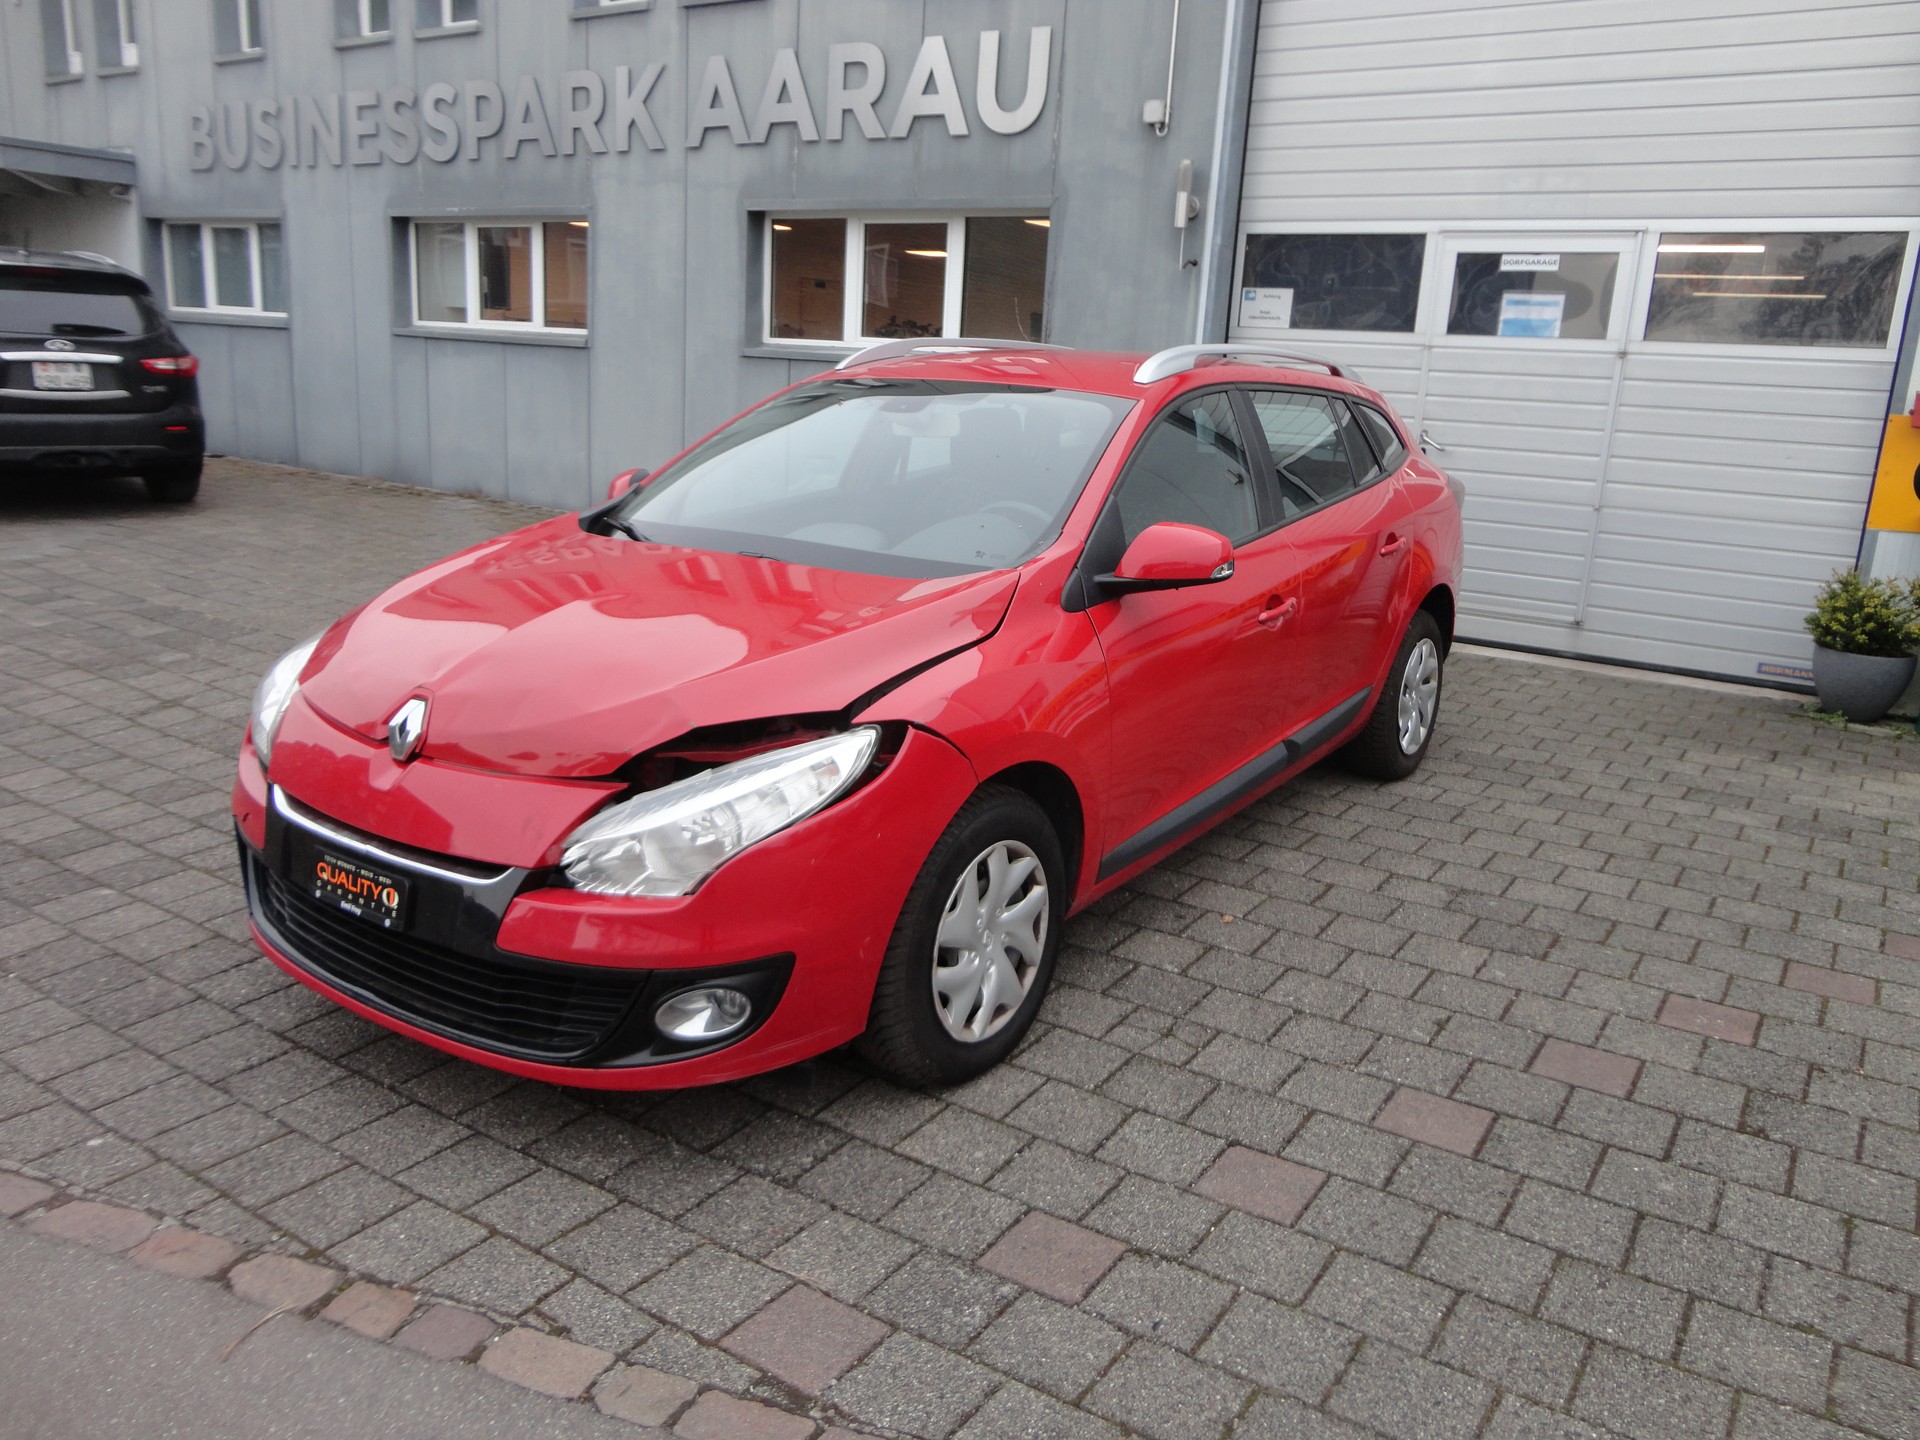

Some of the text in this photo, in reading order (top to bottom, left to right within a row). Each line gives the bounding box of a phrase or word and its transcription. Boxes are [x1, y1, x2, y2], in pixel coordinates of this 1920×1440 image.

[189, 25, 1052, 171] BUSINESSPARK AARAU
[1502, 258, 1559, 266] DORFGARAGE
[317, 861, 382, 901] QUALITY
